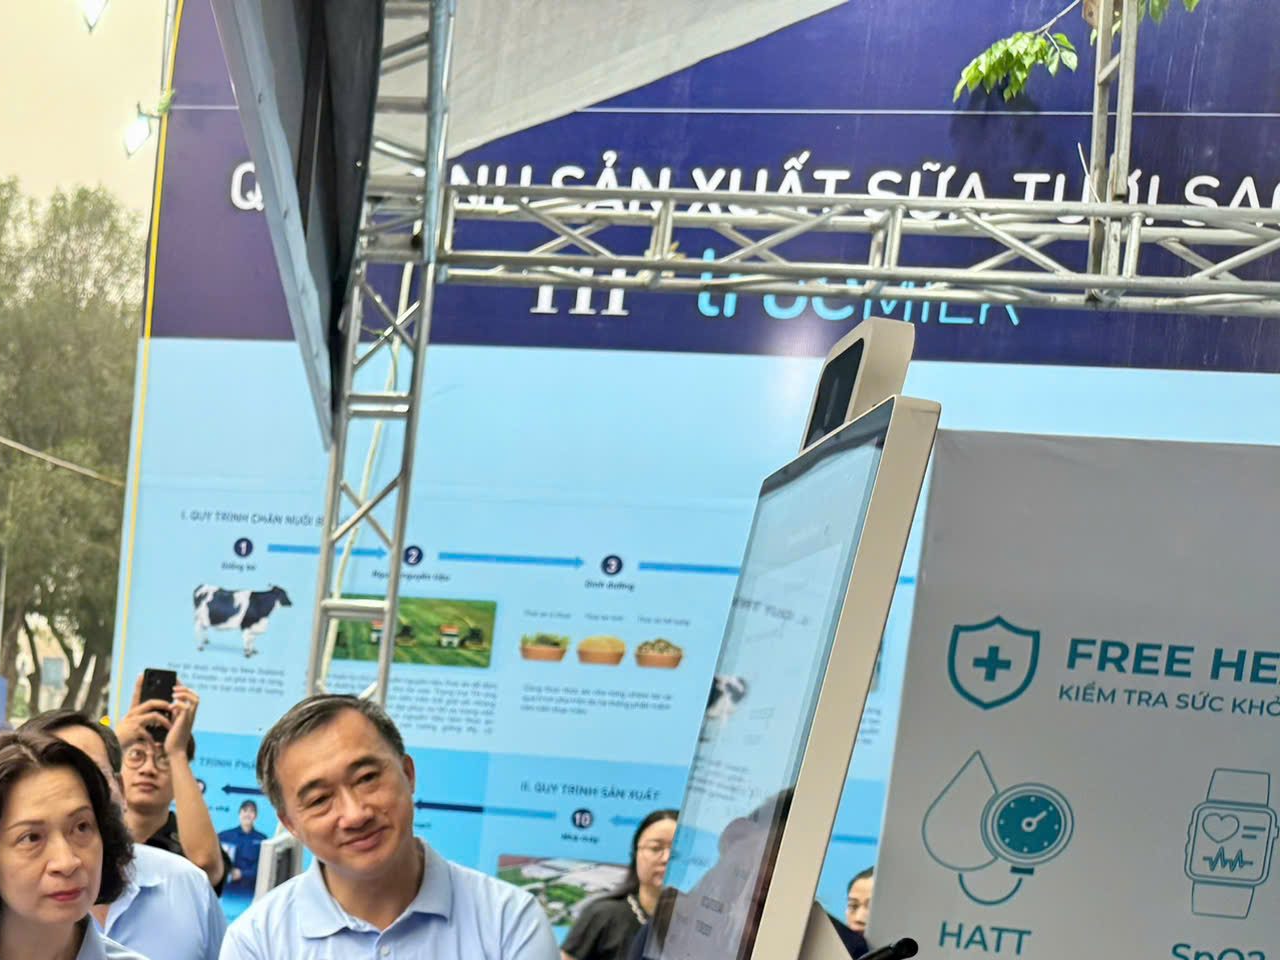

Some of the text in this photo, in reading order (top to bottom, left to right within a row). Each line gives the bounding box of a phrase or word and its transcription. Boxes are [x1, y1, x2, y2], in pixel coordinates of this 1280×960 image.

[1066, 637, 1280, 685] FREE HE
[1058, 681, 1116, 704] KIỂM
[1123, 688, 1169, 708] TRA
[1175, 690, 1224, 713] SỨC
[939, 921, 1032, 955] HATT
